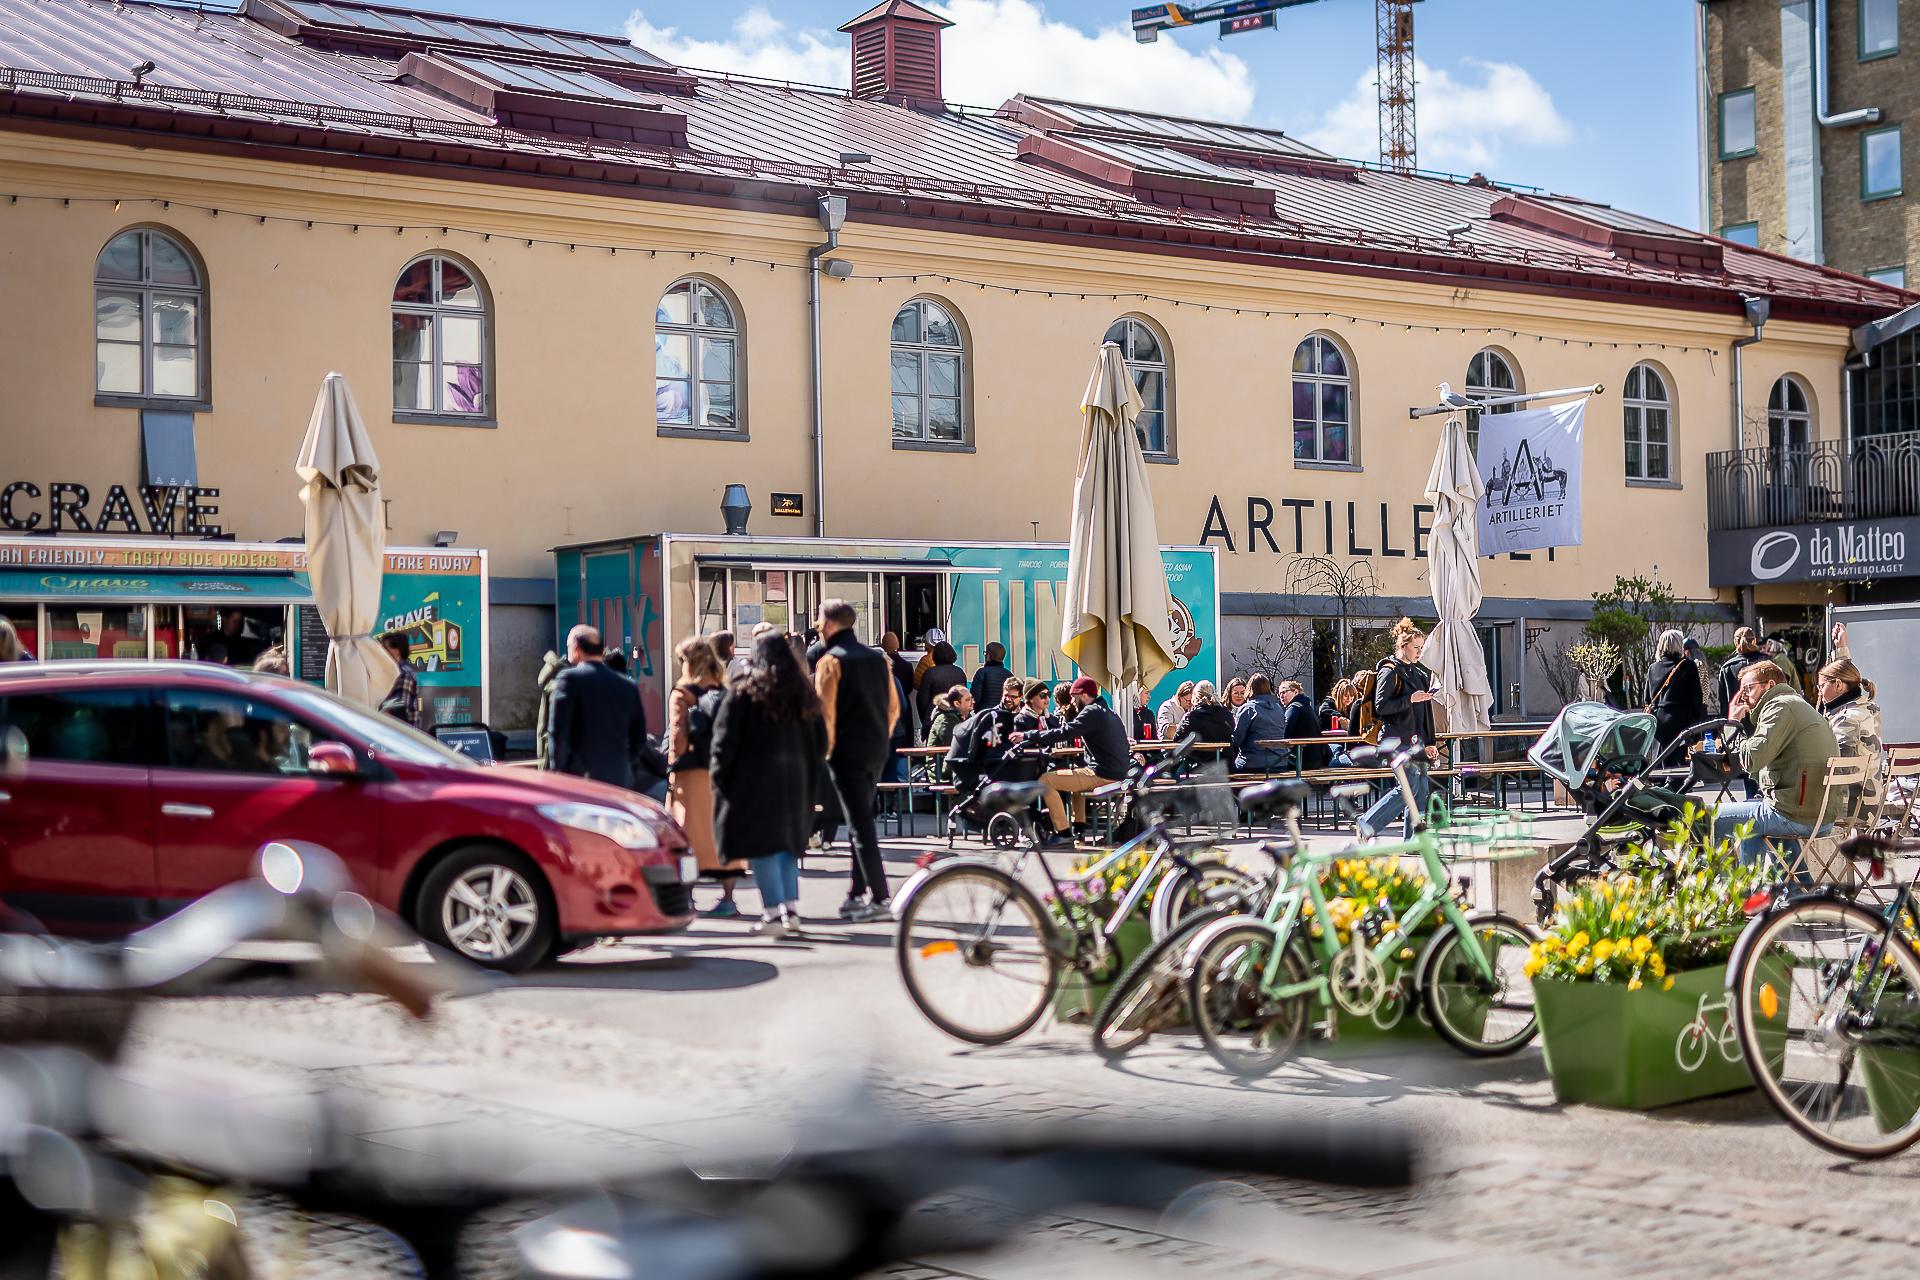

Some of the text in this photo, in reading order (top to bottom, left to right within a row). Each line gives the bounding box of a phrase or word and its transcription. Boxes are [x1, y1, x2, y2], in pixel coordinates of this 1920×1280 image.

[0, 481, 222, 535] CRAVE
[1488, 504, 1565, 526] ARTILLERIET
[29, 549, 105, 564] FRIENDLY
[122, 551, 173, 566] TASTY
[178, 552, 213, 566] SIDE
[218, 553, 278, 567] ORDERS
[1810, 525, 1905, 566] da Matteo
[388, 556, 472, 571] TAKE AWAY
[384, 605, 433, 632] CRAVE
[963, 579, 1073, 681] JIN
